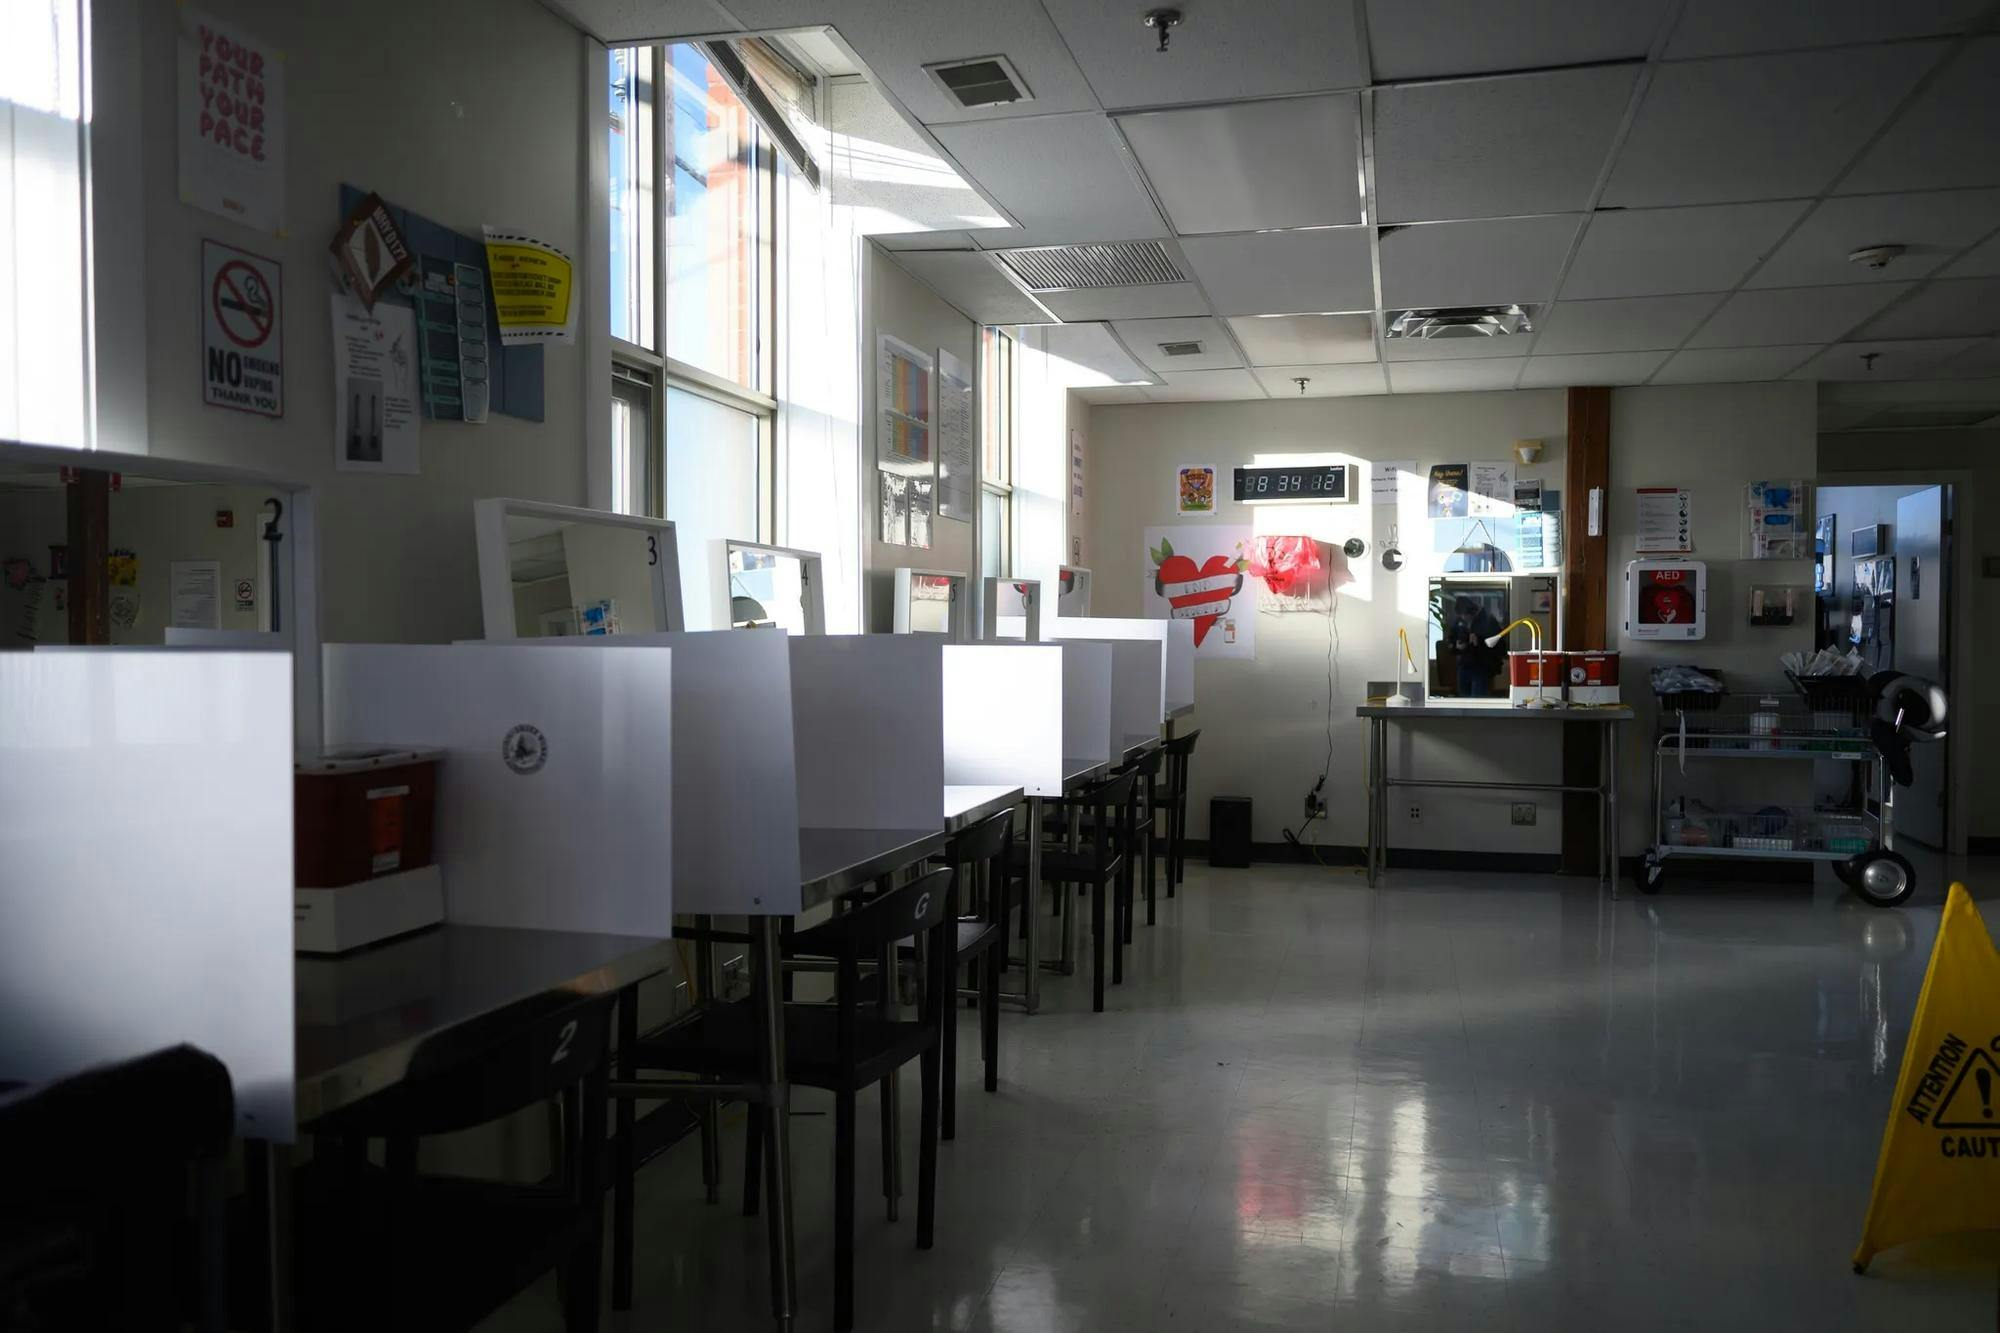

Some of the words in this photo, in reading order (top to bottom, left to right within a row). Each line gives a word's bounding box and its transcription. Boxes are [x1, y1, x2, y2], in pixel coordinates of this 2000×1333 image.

[198, 24, 264, 78] YOUR
[199, 52, 264, 105] PATH
[199, 81, 264, 133] YOUR
[199, 110, 265, 161] PACE
[209, 346, 242, 387] NO
[211, 387, 252, 407] THANK
[254, 396, 277, 411] YOU
[647, 536, 657, 565] 3
[801, 563, 808, 586] 4
[1655, 571, 1680, 581] AED
[550, 1019, 578, 1065] 2
[1906, 1032, 1967, 1125] ATTENTION
